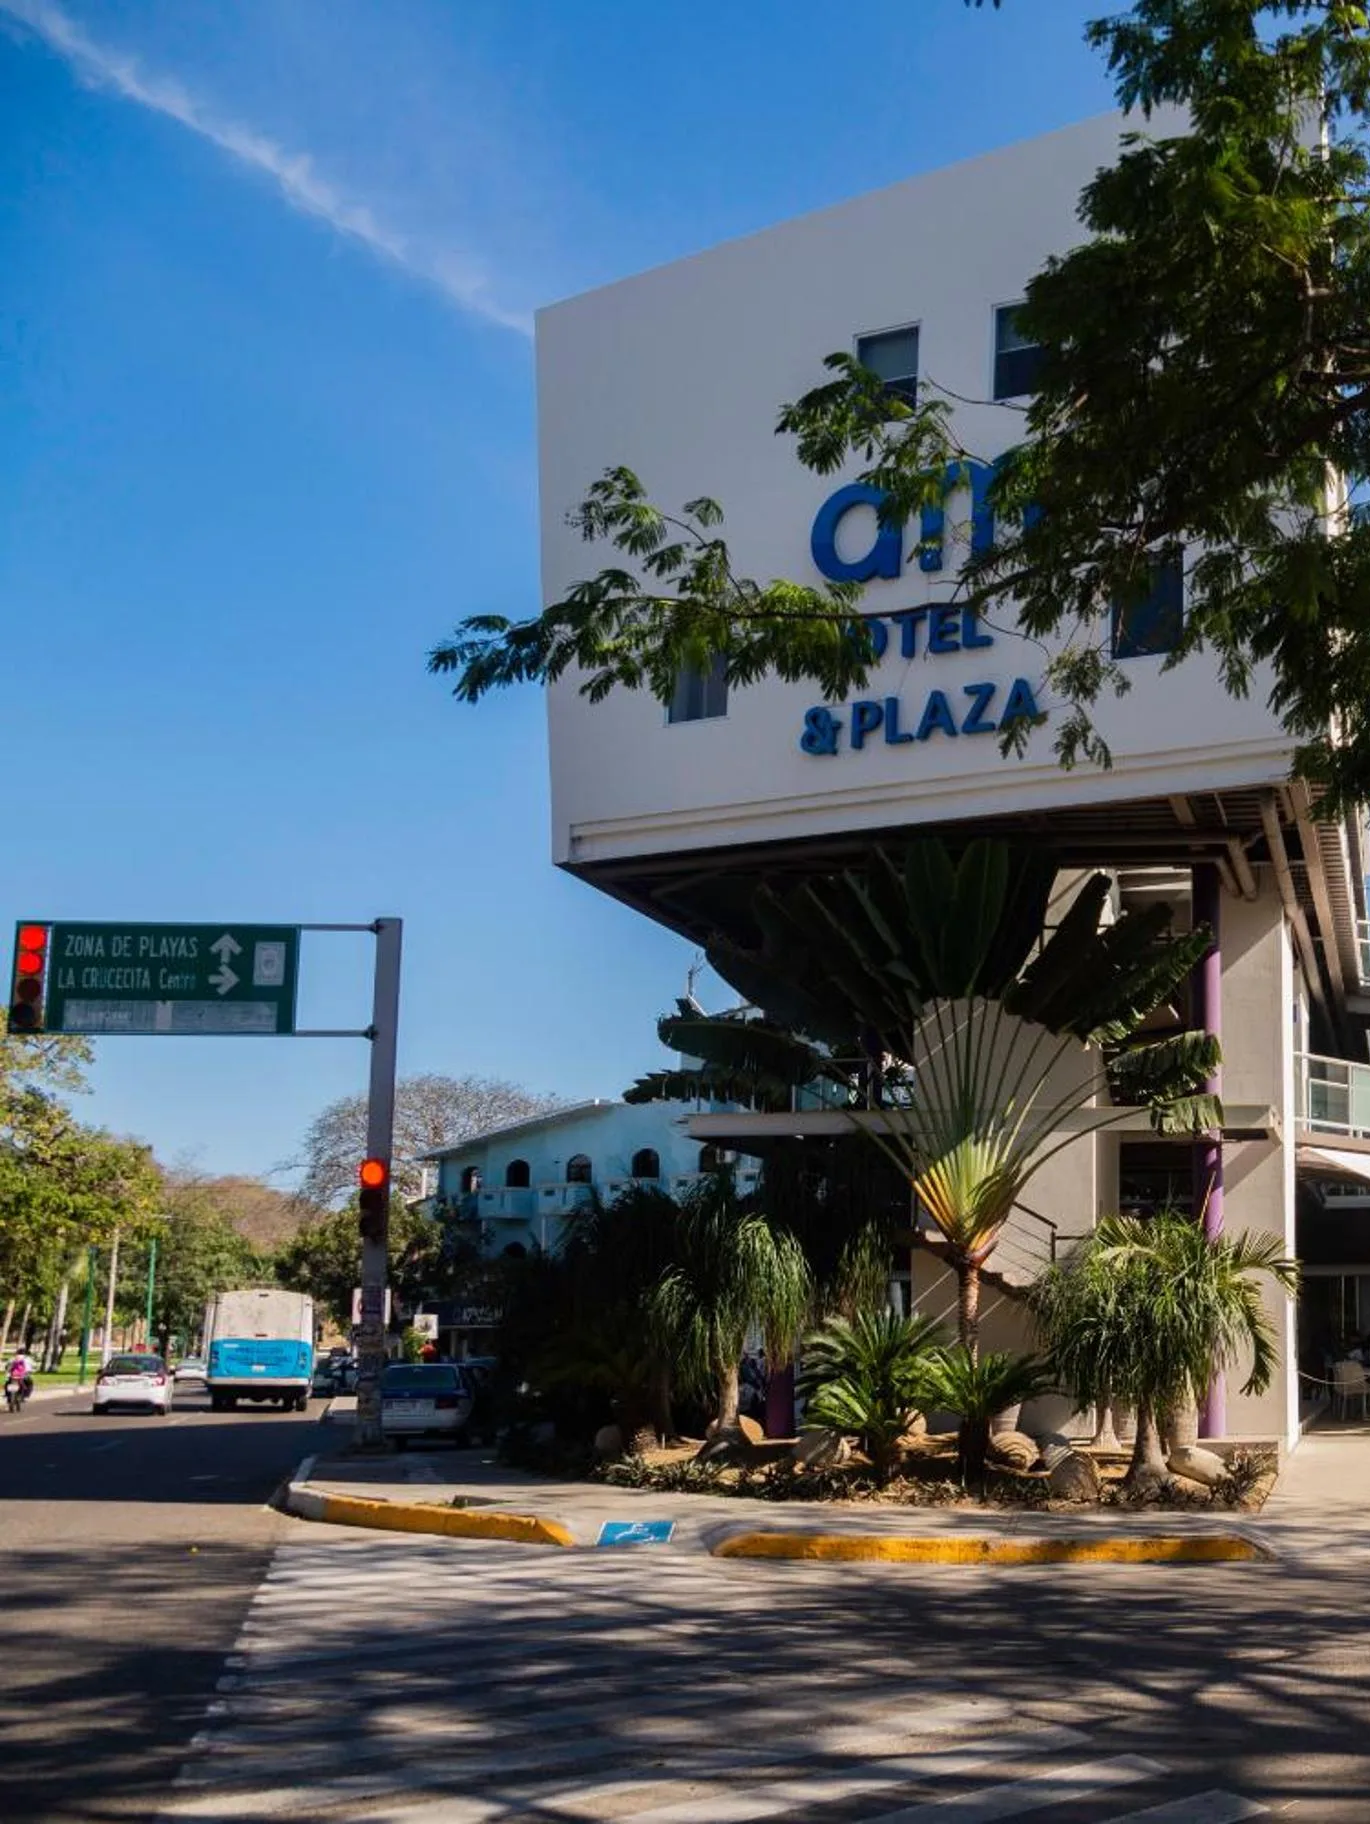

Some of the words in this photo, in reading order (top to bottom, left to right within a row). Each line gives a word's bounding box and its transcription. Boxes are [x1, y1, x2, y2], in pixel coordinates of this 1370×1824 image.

[800, 706, 842, 756] &
[851, 678, 1040, 750] PLAZA
[64, 934, 105, 957] ZONA
[112, 935, 132, 957] DE
[139, 935, 198, 958] PLAYAS
[57, 967, 75, 989] LA
[82, 967, 150, 989] CRUCECITA
